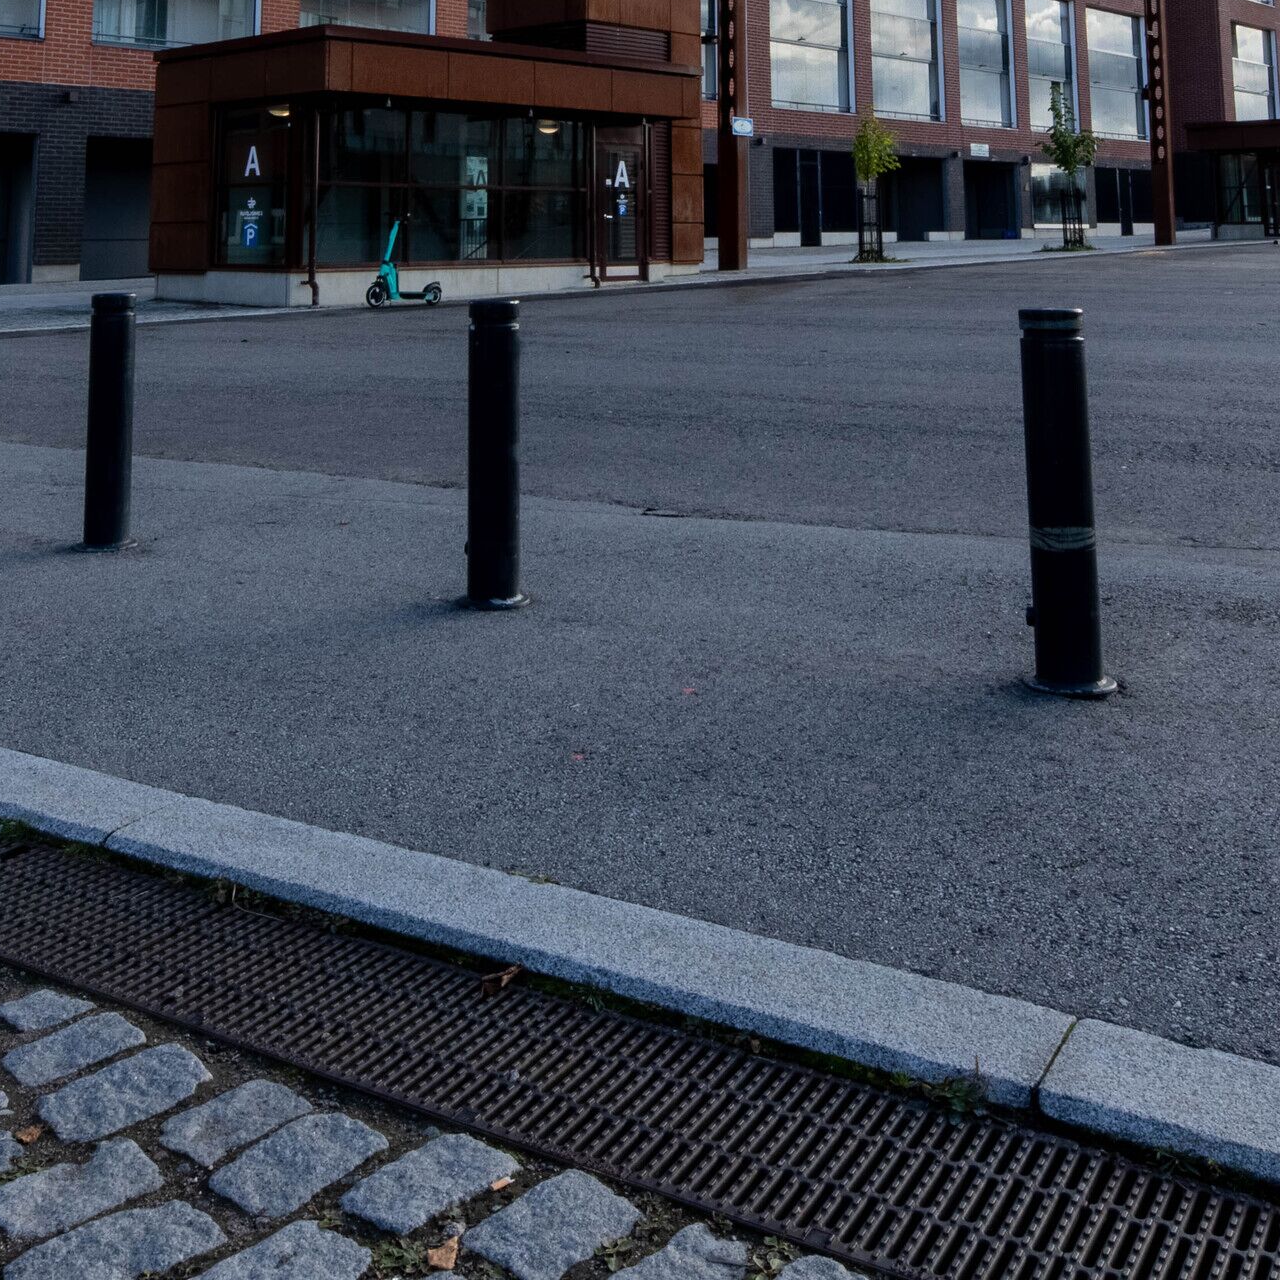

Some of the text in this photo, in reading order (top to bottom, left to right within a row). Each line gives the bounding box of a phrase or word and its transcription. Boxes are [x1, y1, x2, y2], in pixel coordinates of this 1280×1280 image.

[245, 145, 260, 177] A
[614, 160, 630, 188] A
[246, 228, 256, 246] P
